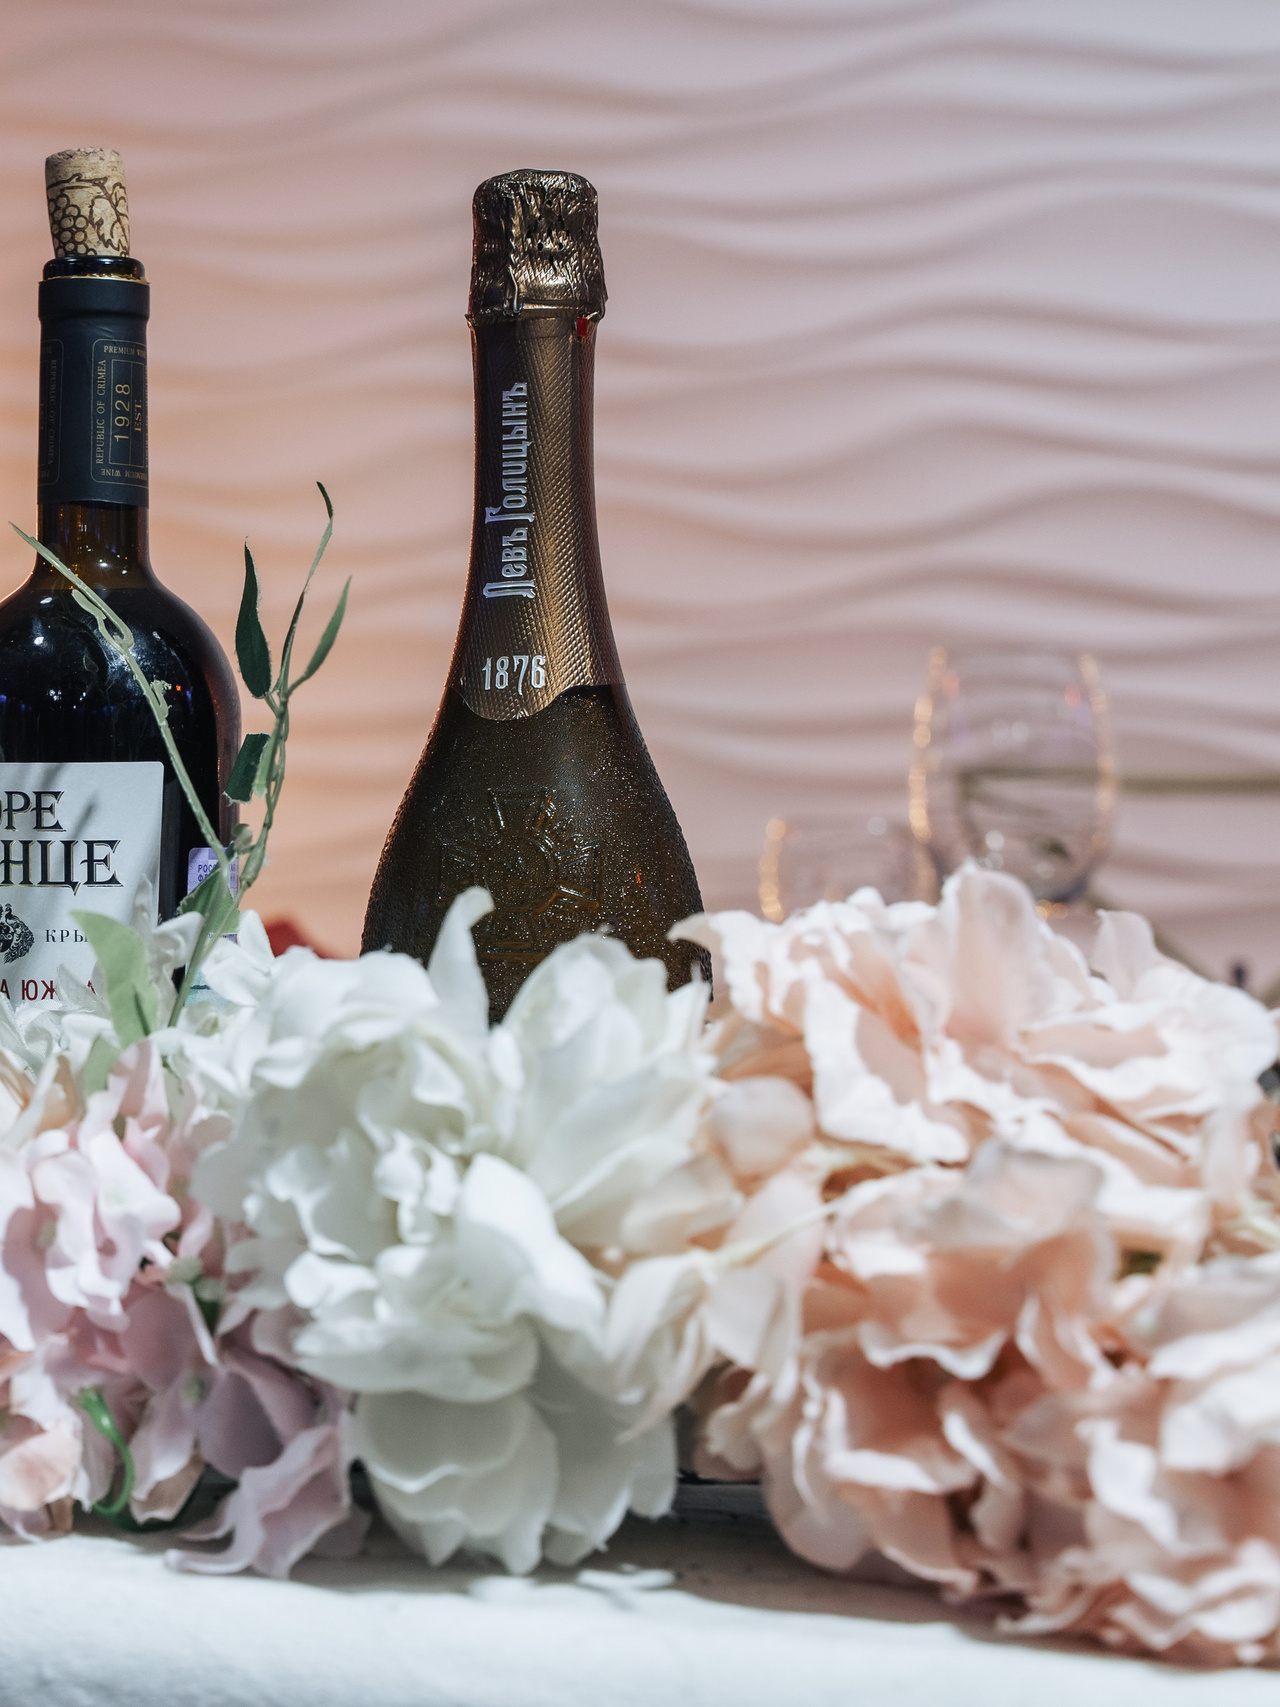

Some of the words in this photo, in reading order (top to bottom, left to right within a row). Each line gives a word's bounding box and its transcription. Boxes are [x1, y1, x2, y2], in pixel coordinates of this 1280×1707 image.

[103, 345, 135, 356] PREMIUM
[97, 360, 106, 396] CRIMEA
[97, 401, 105, 414] OF
[114, 384, 131, 442] 1928
[96, 419, 105, 463] REPUBLIC
[100, 468, 121, 477] WINE
[482, 655, 546, 696] 1876
[45, 928, 89, 943] КРЫ
